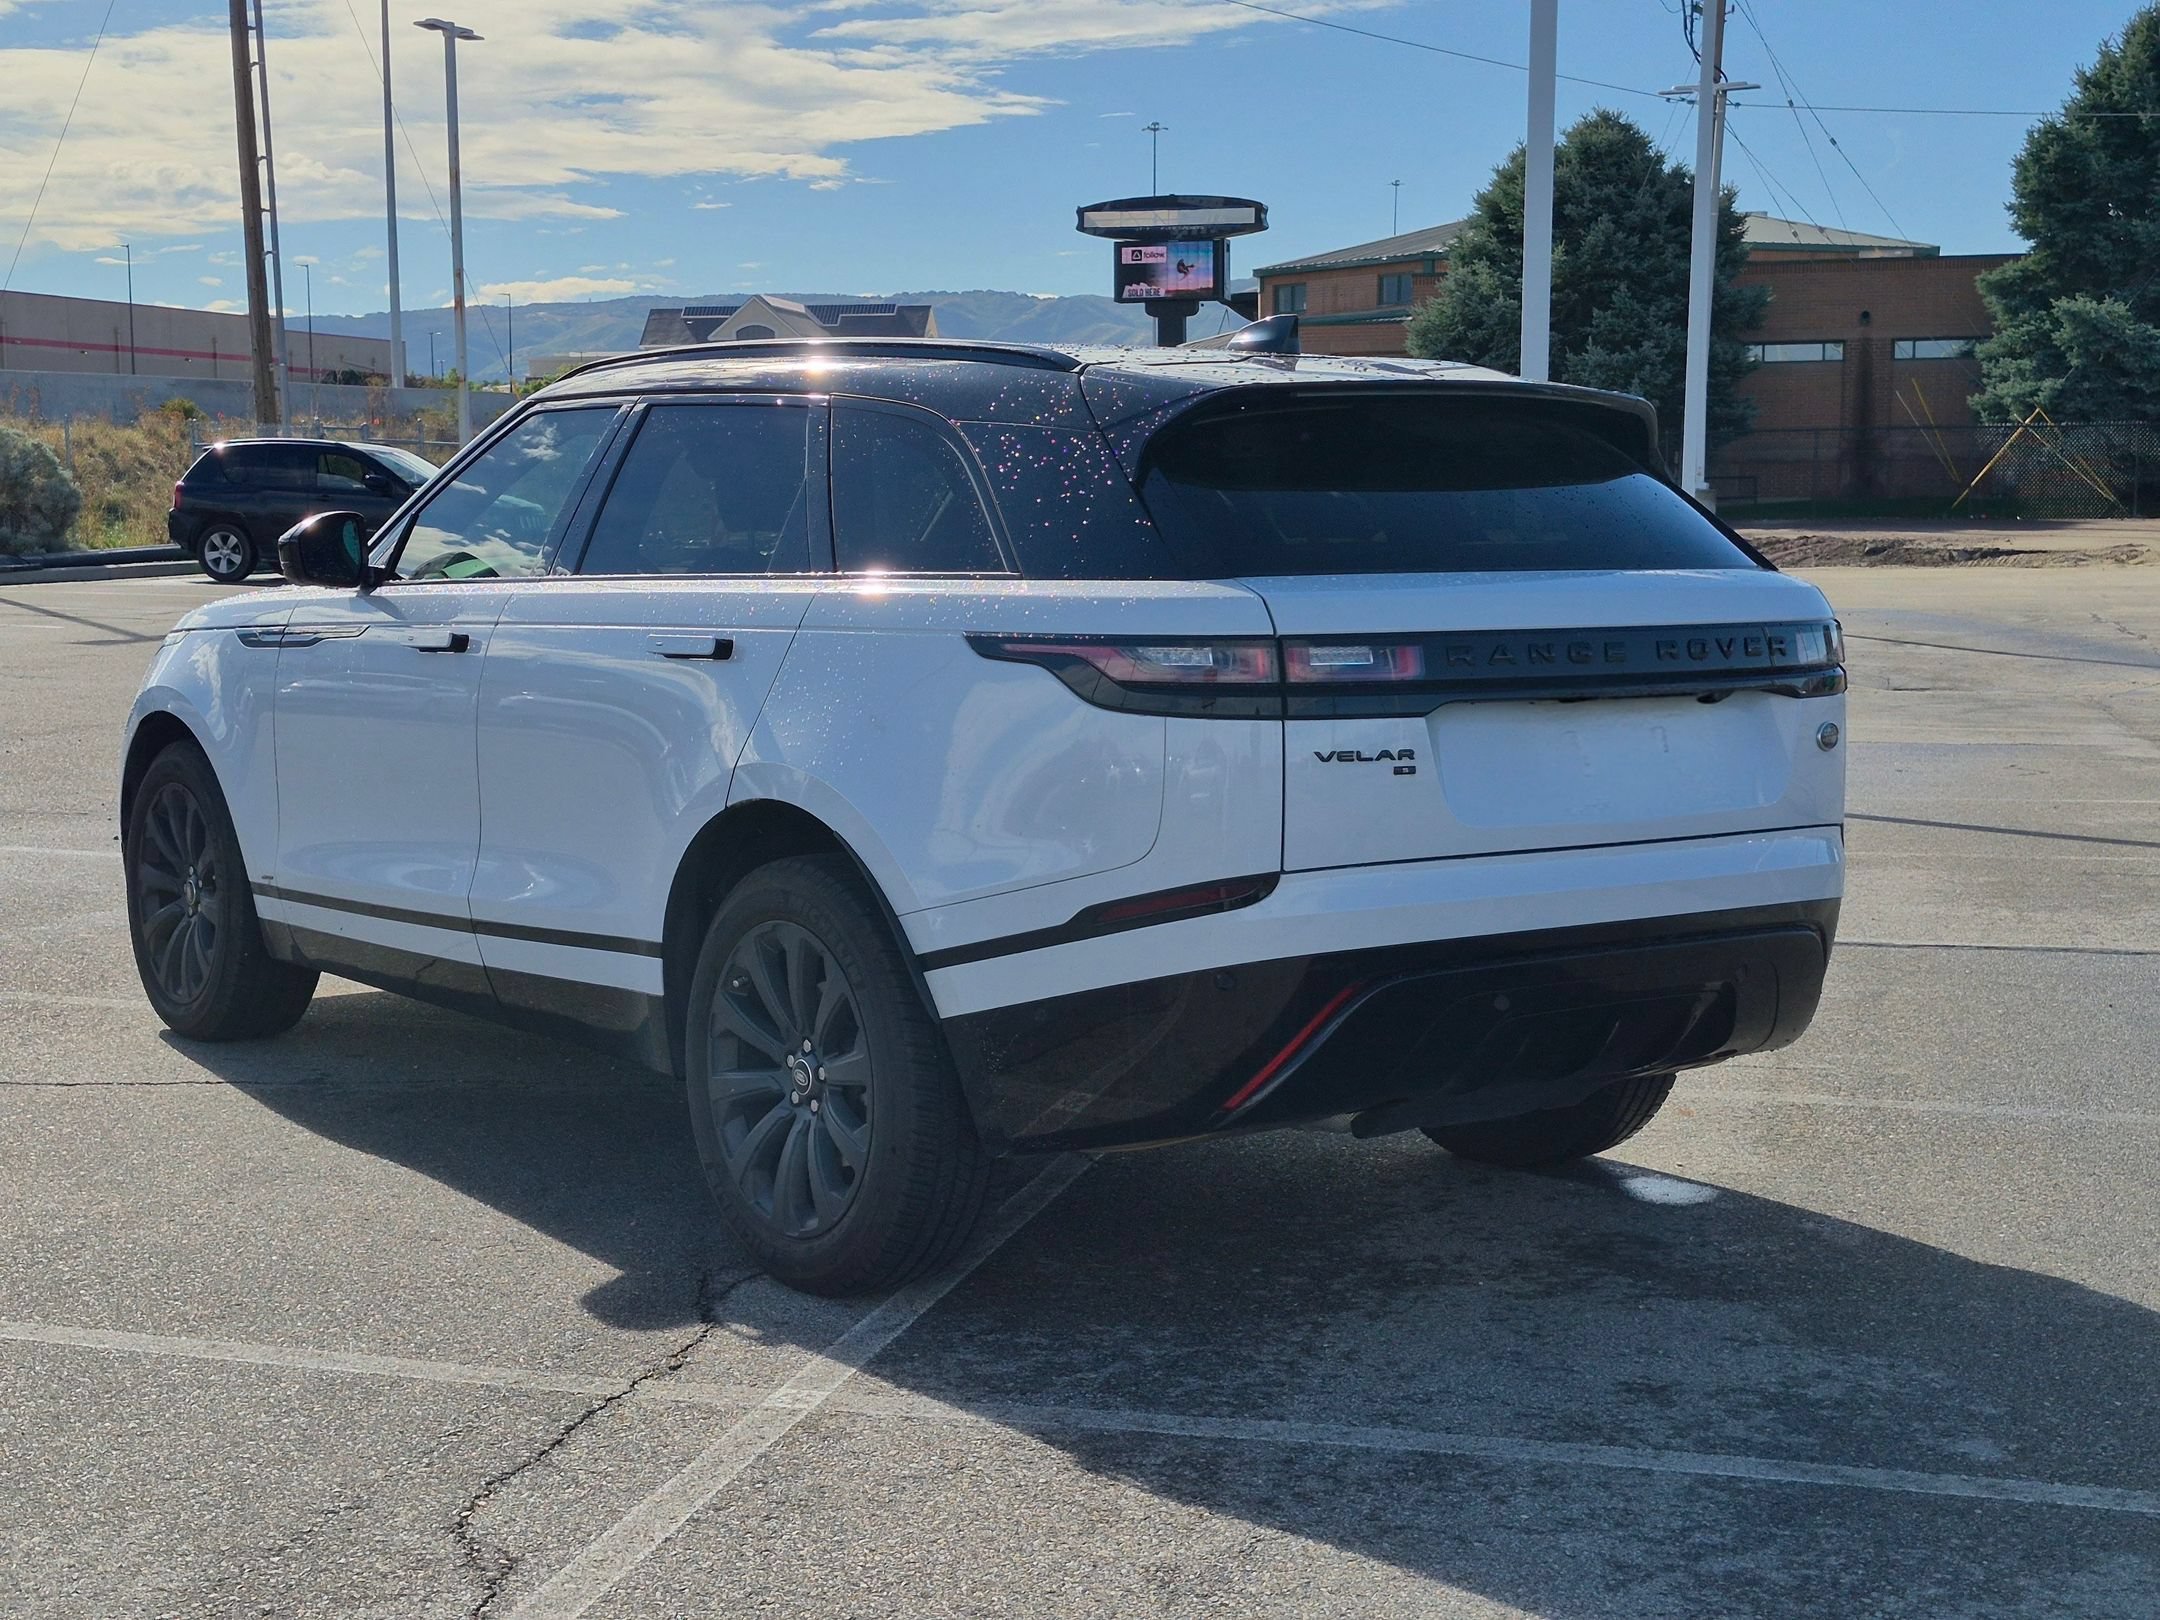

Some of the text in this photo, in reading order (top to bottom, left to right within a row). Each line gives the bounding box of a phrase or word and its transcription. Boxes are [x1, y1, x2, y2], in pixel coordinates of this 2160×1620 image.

[1144, 251, 1165, 259] follow
[1127, 287, 1161, 297] SOLD HERE
[1445, 635, 1787, 667] RANGE ROVER
[1313, 748, 1416, 763] VELAR
